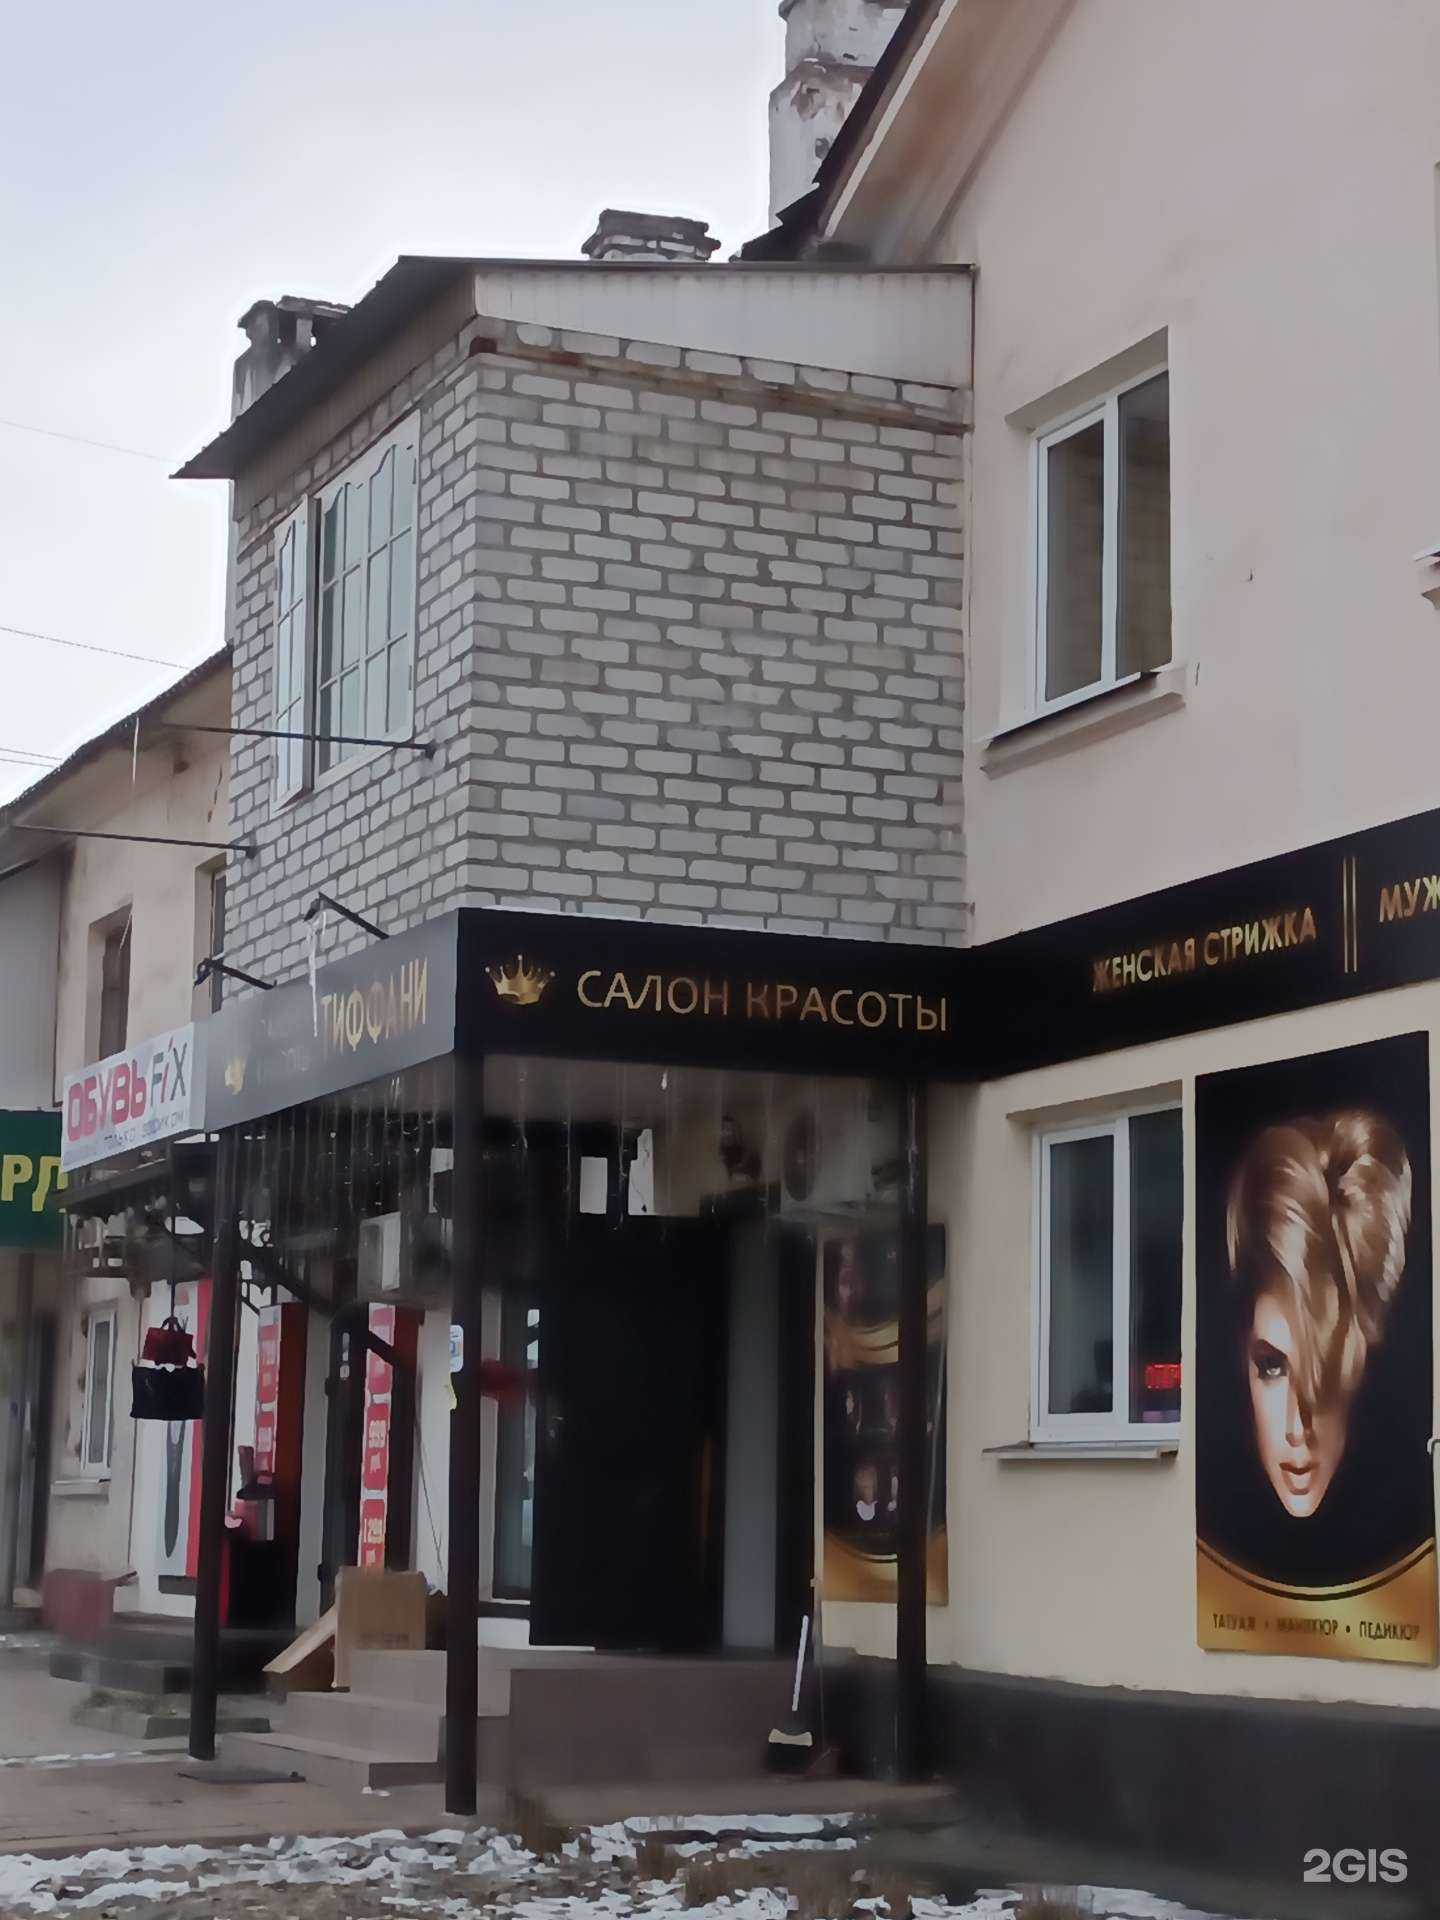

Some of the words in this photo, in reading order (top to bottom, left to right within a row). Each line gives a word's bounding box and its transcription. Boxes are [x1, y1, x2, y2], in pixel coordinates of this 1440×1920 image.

[1092, 937, 1195, 992] ЖЕНСКАЯ
[1203, 907, 1317, 966] СТРИЖКА
[320, 957, 428, 1058] ТИФФАНИ
[577, 970, 729, 1016] САЛОН
[746, 981, 947, 1032] КРАСОТЫ
[67, 1059, 147, 1142] ОБУВЬ
[1359, 1620, 1420, 1640] ПЕДИКЮР
